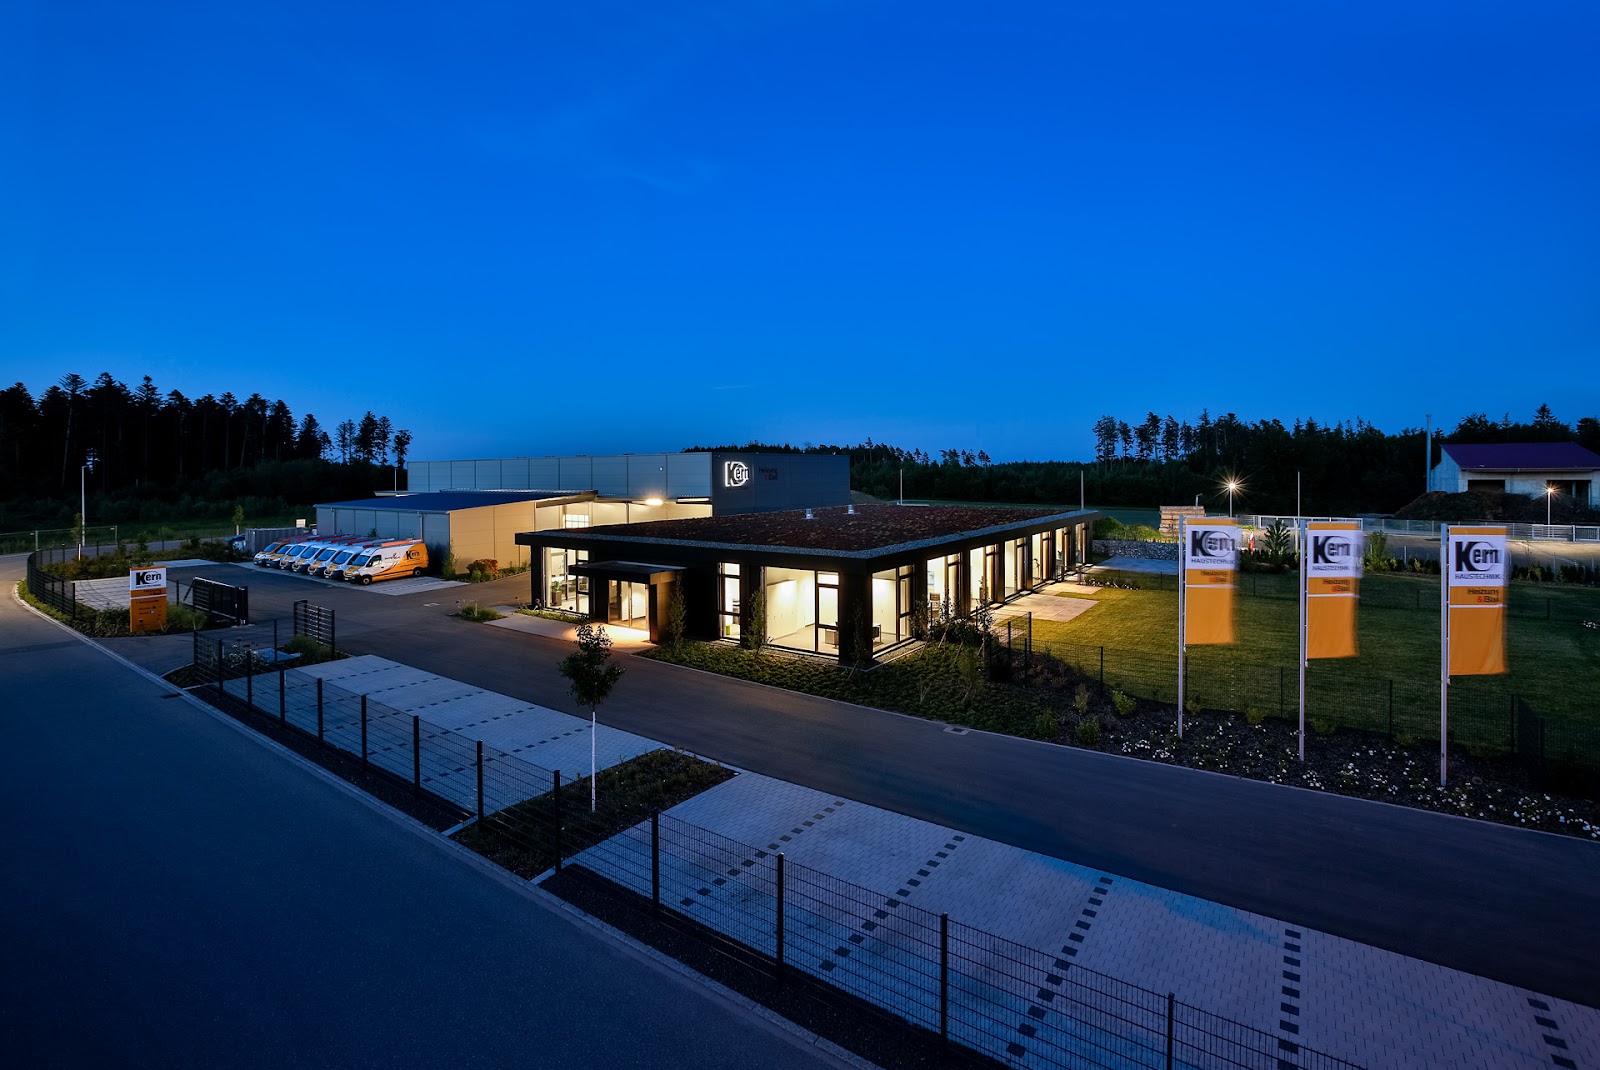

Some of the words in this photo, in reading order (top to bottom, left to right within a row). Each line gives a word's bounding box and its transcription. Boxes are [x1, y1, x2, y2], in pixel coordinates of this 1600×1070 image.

[725, 461, 750, 487] Kern
[406, 550, 421, 560] Kern
[1191, 530, 1236, 557] Kern
[1313, 535, 1351, 564] Kern
[1455, 541, 1499, 572] Kern
[136, 571, 162, 585] Kern
